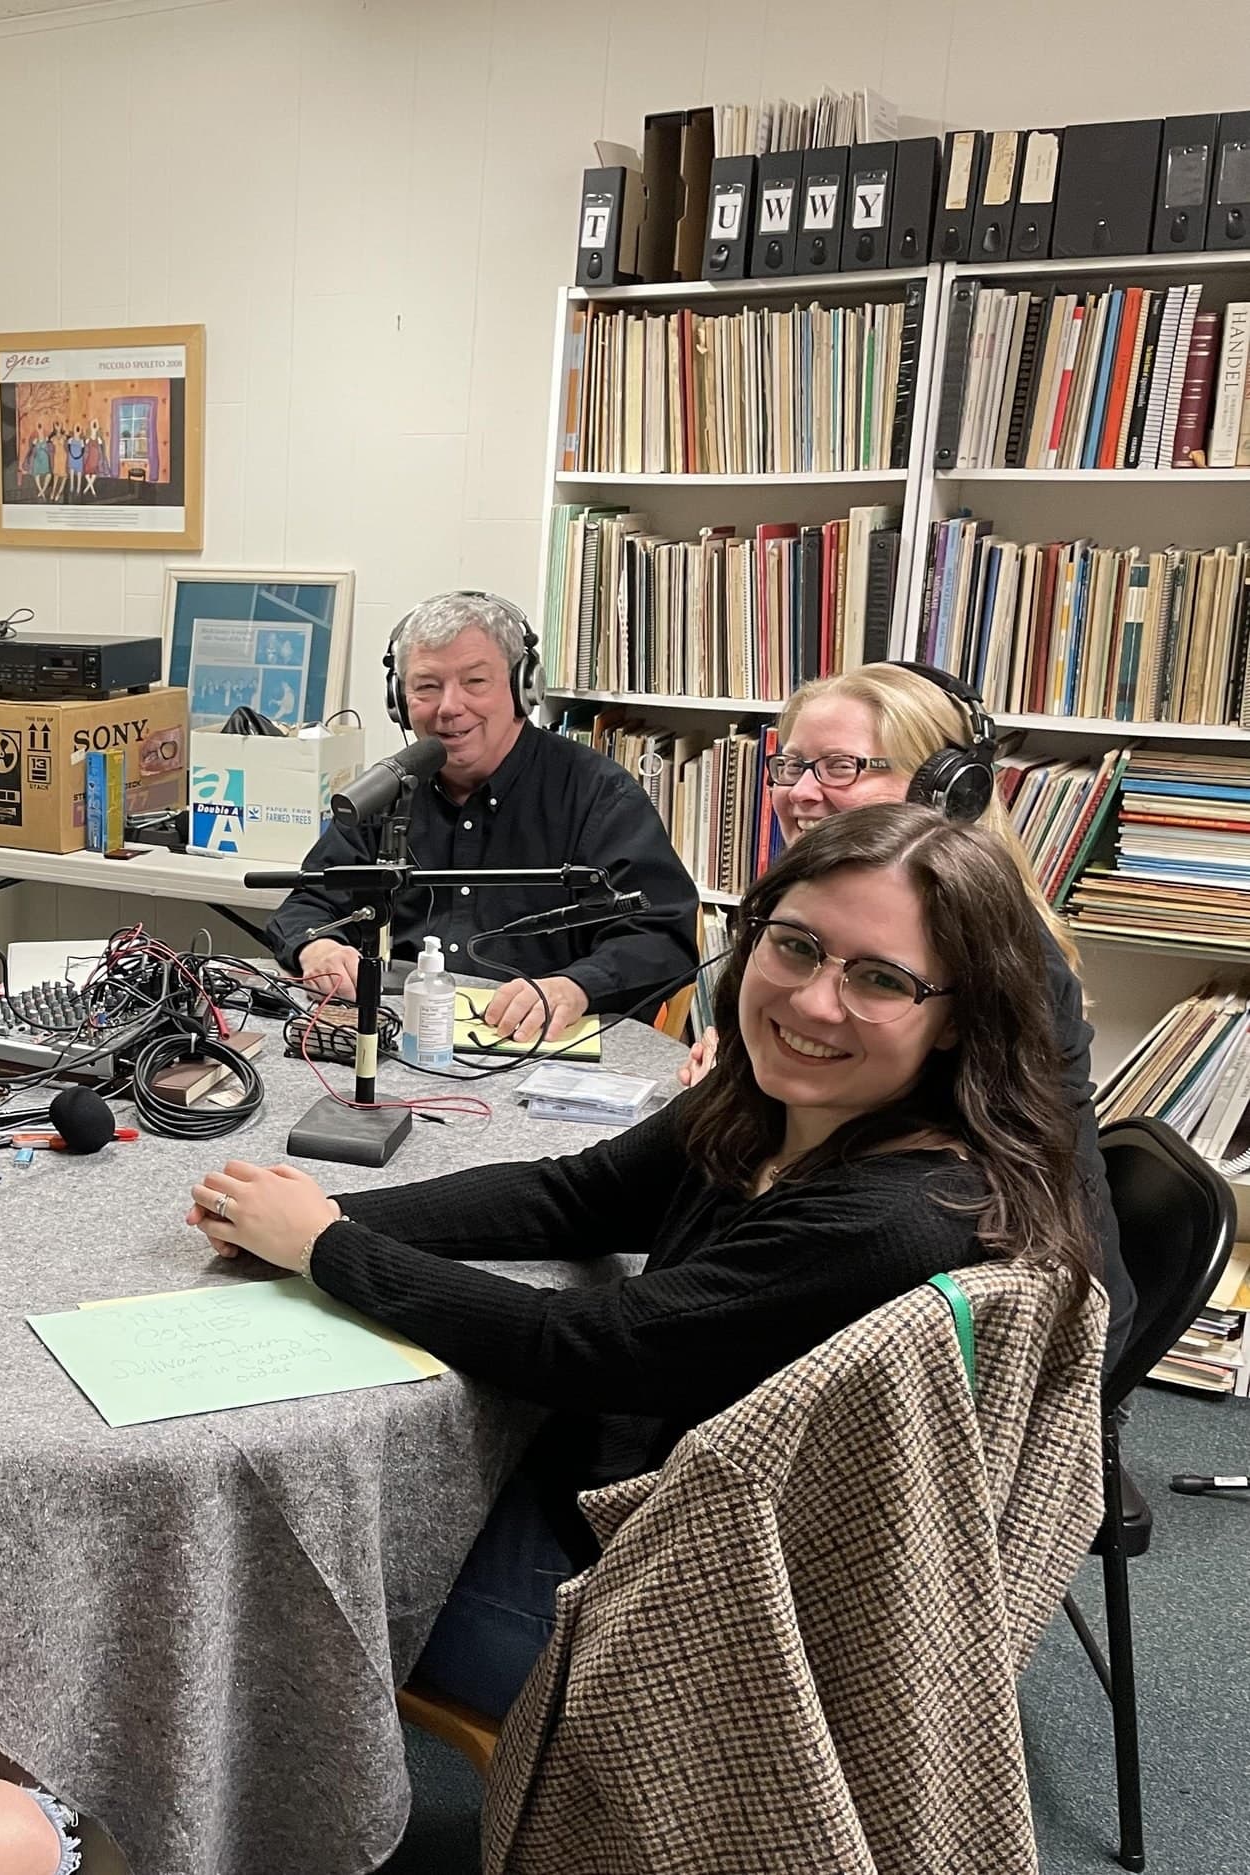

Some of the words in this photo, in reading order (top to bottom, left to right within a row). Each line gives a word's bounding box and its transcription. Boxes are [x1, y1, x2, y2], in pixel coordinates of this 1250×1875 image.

[718, 205, 738, 229] U
[766, 198, 790, 221] W
[809, 195, 835, 217] W
[859, 194, 880, 219] Y
[588, 215, 605, 237] T
[1224, 310, 1248, 393] HANDEL
[98, 361, 131, 370] PICCOLO
[132, 360, 165, 369] SPOLETO
[74, 719, 148, 753] SONY
[32, 759, 46, 768] 13
[197, 804, 229, 815] Double
[231, 807, 239, 816] A
[266, 814, 291, 823] FARMED
[292, 815, 312, 825] TREES
